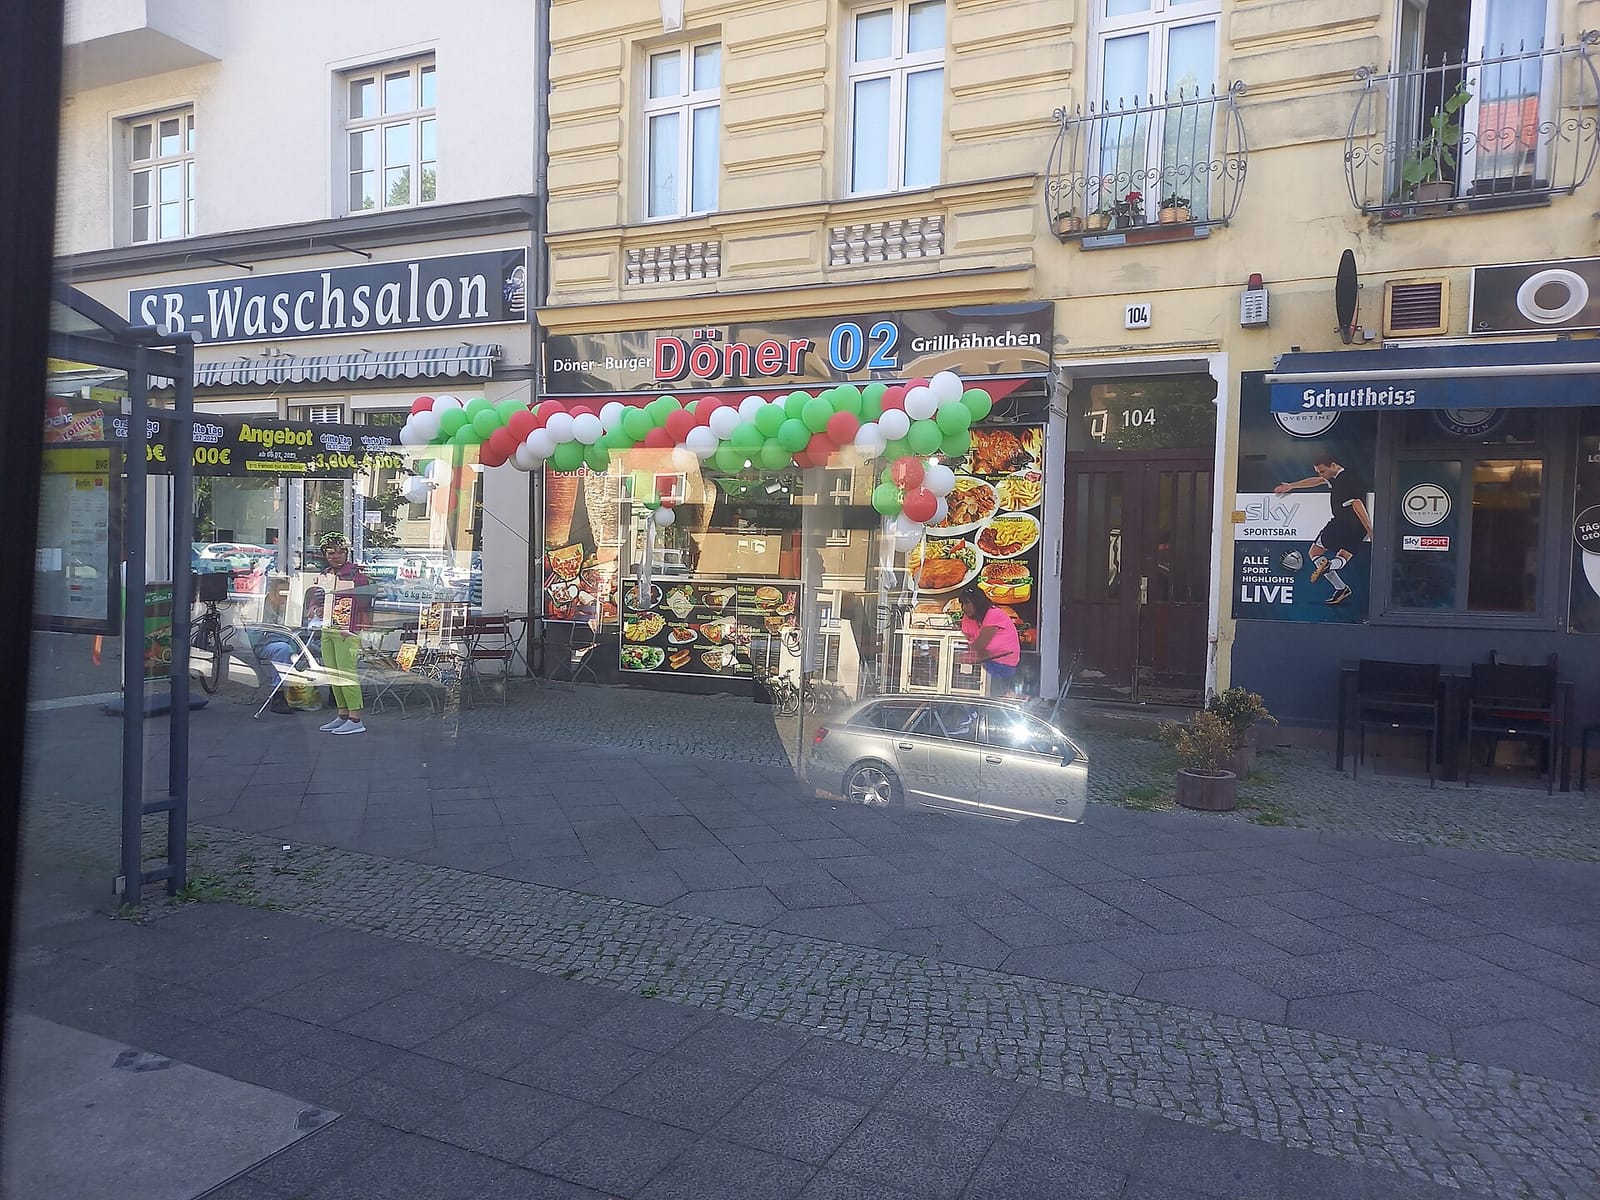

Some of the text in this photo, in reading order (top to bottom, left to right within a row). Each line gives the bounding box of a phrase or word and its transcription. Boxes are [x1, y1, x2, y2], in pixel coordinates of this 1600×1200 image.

[141, 264, 489, 339] SB-Waschsalon
[1128, 306, 1148, 324] 104
[911, 329, 1041, 353] Grillhähnchen
[653, 320, 901, 382] Döner 02
[553, 357, 594, 373] Döner
[605, 355, 652, 373] Burger
[1302, 386, 1416, 409] Schultheiss
[1122, 408, 1157, 427] 104
[1283, 414, 1331, 422] OVERTIME
[239, 424, 313, 448] Angebot
[1245, 496, 1300, 527] sky
[1408, 495, 1444, 512] OT
[1243, 528, 1297, 536] SPORTSBAR
[1579, 523, 1600, 533] TÄG
[1404, 537, 1447, 546] sky sport
[1242, 556, 1270, 565] ALLE
[1242, 575, 1295, 584] HIGHLIGHTS
[1240, 584, 1294, 604] LIVE
